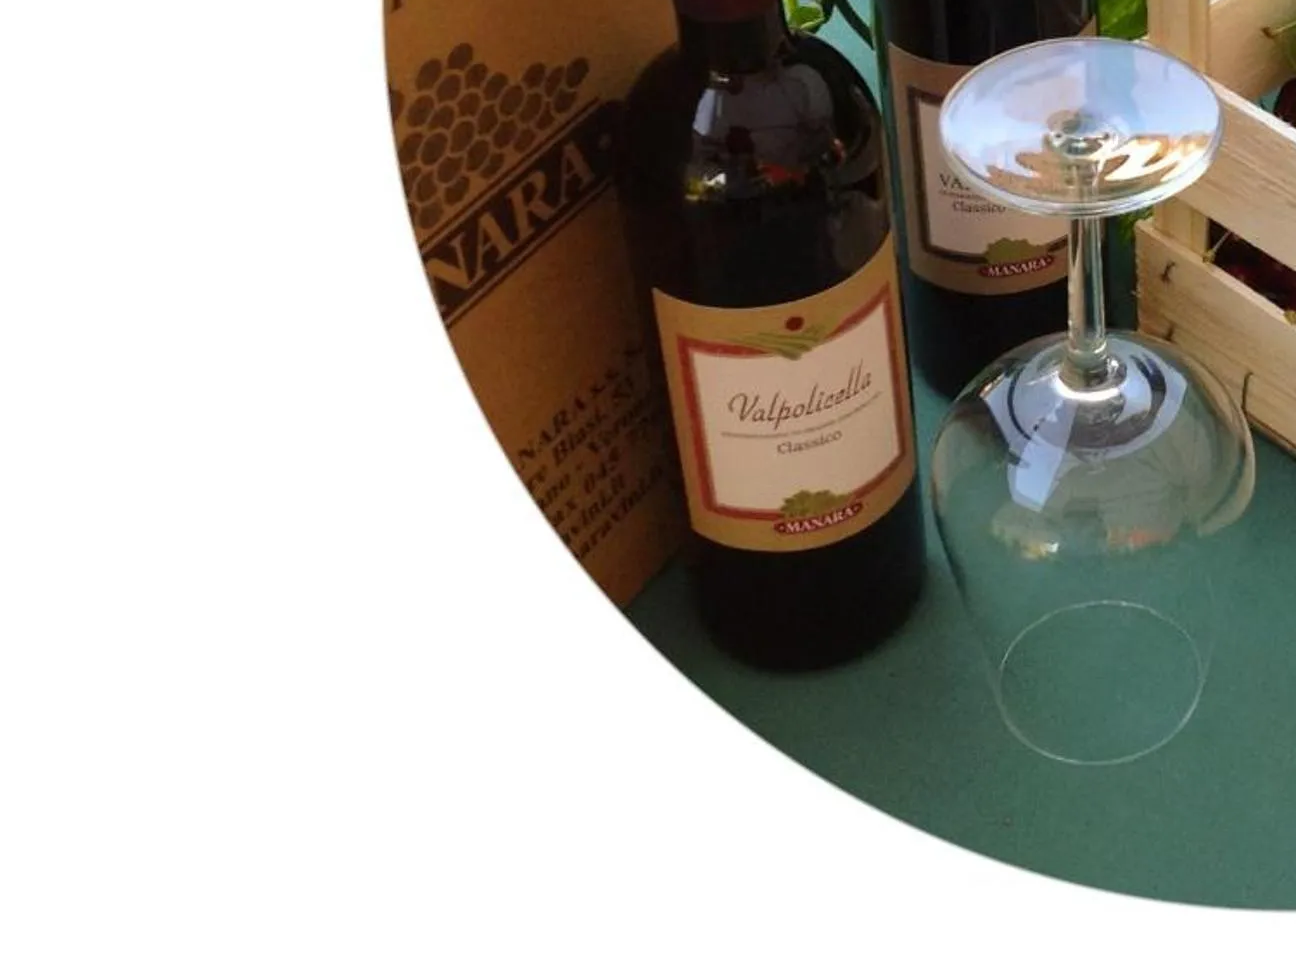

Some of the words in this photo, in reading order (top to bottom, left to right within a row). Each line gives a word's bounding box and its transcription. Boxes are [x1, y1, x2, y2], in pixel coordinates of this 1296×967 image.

[987, 258, 1047, 277] MANARA
[727, 358, 872, 431] Valpolicella
[776, 429, 844, 455] Classico
[786, 506, 855, 532] MANARA
